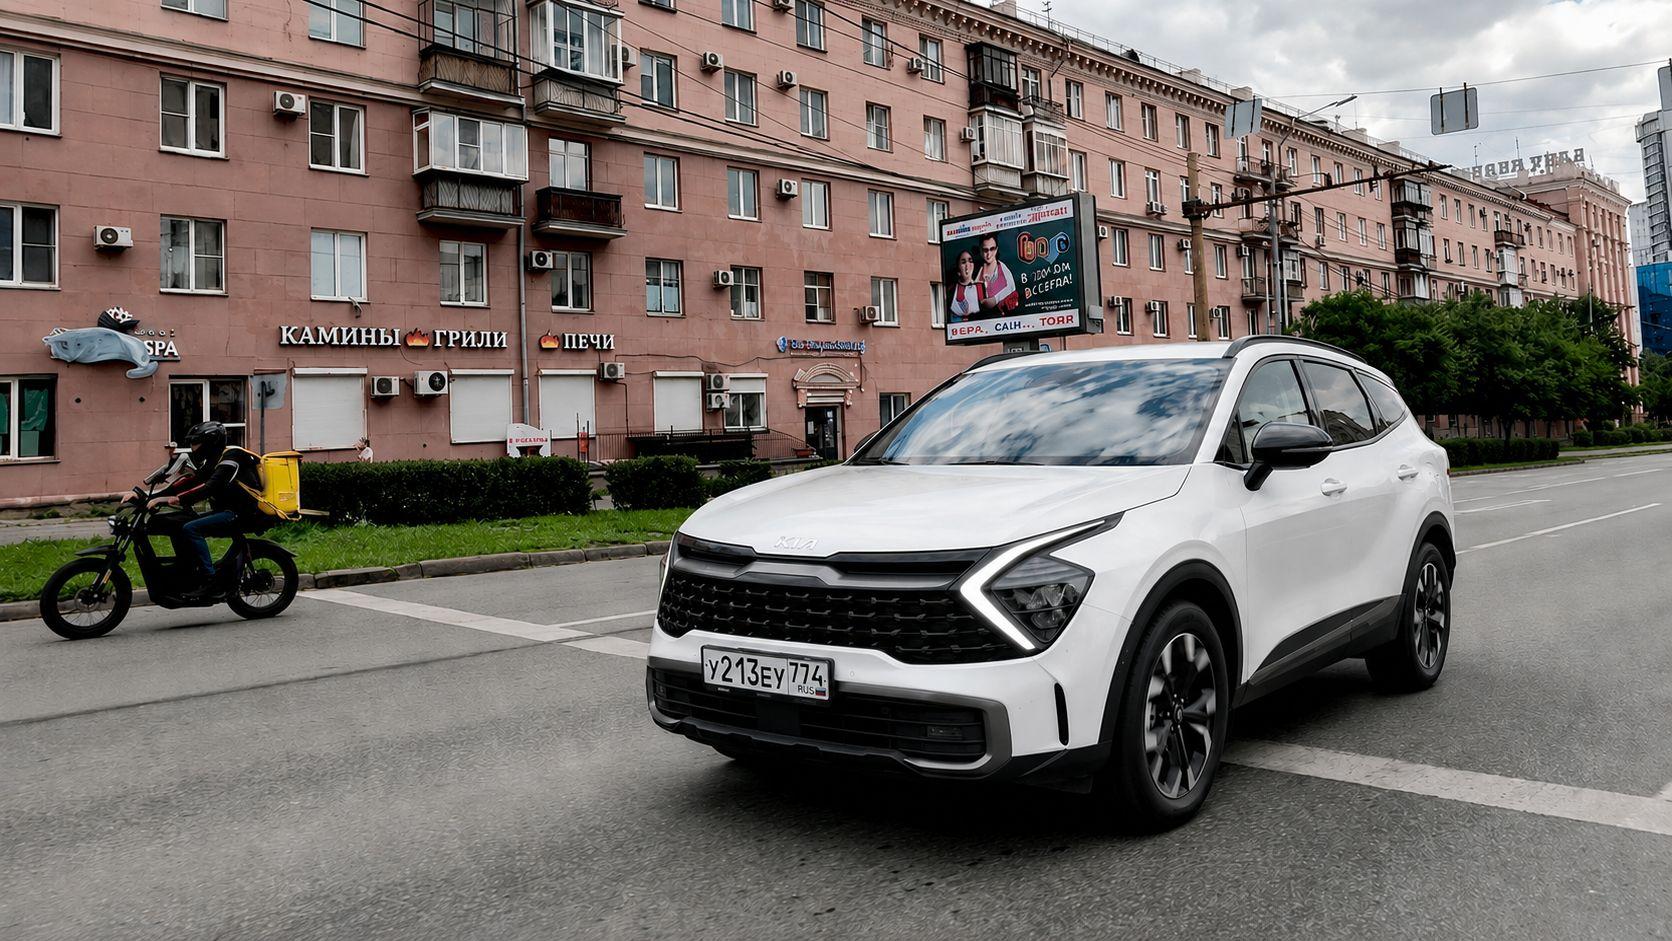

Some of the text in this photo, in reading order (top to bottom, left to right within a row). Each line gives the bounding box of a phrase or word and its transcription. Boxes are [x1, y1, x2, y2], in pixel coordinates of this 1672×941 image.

[280, 325, 615, 350] КАМИНЫ ГРИЛИ ПЕЧИ
[774, 536, 818, 550] KIA
[708, 655, 823, 690] У213ЕУ 774
[797, 685, 815, 696] RUS
